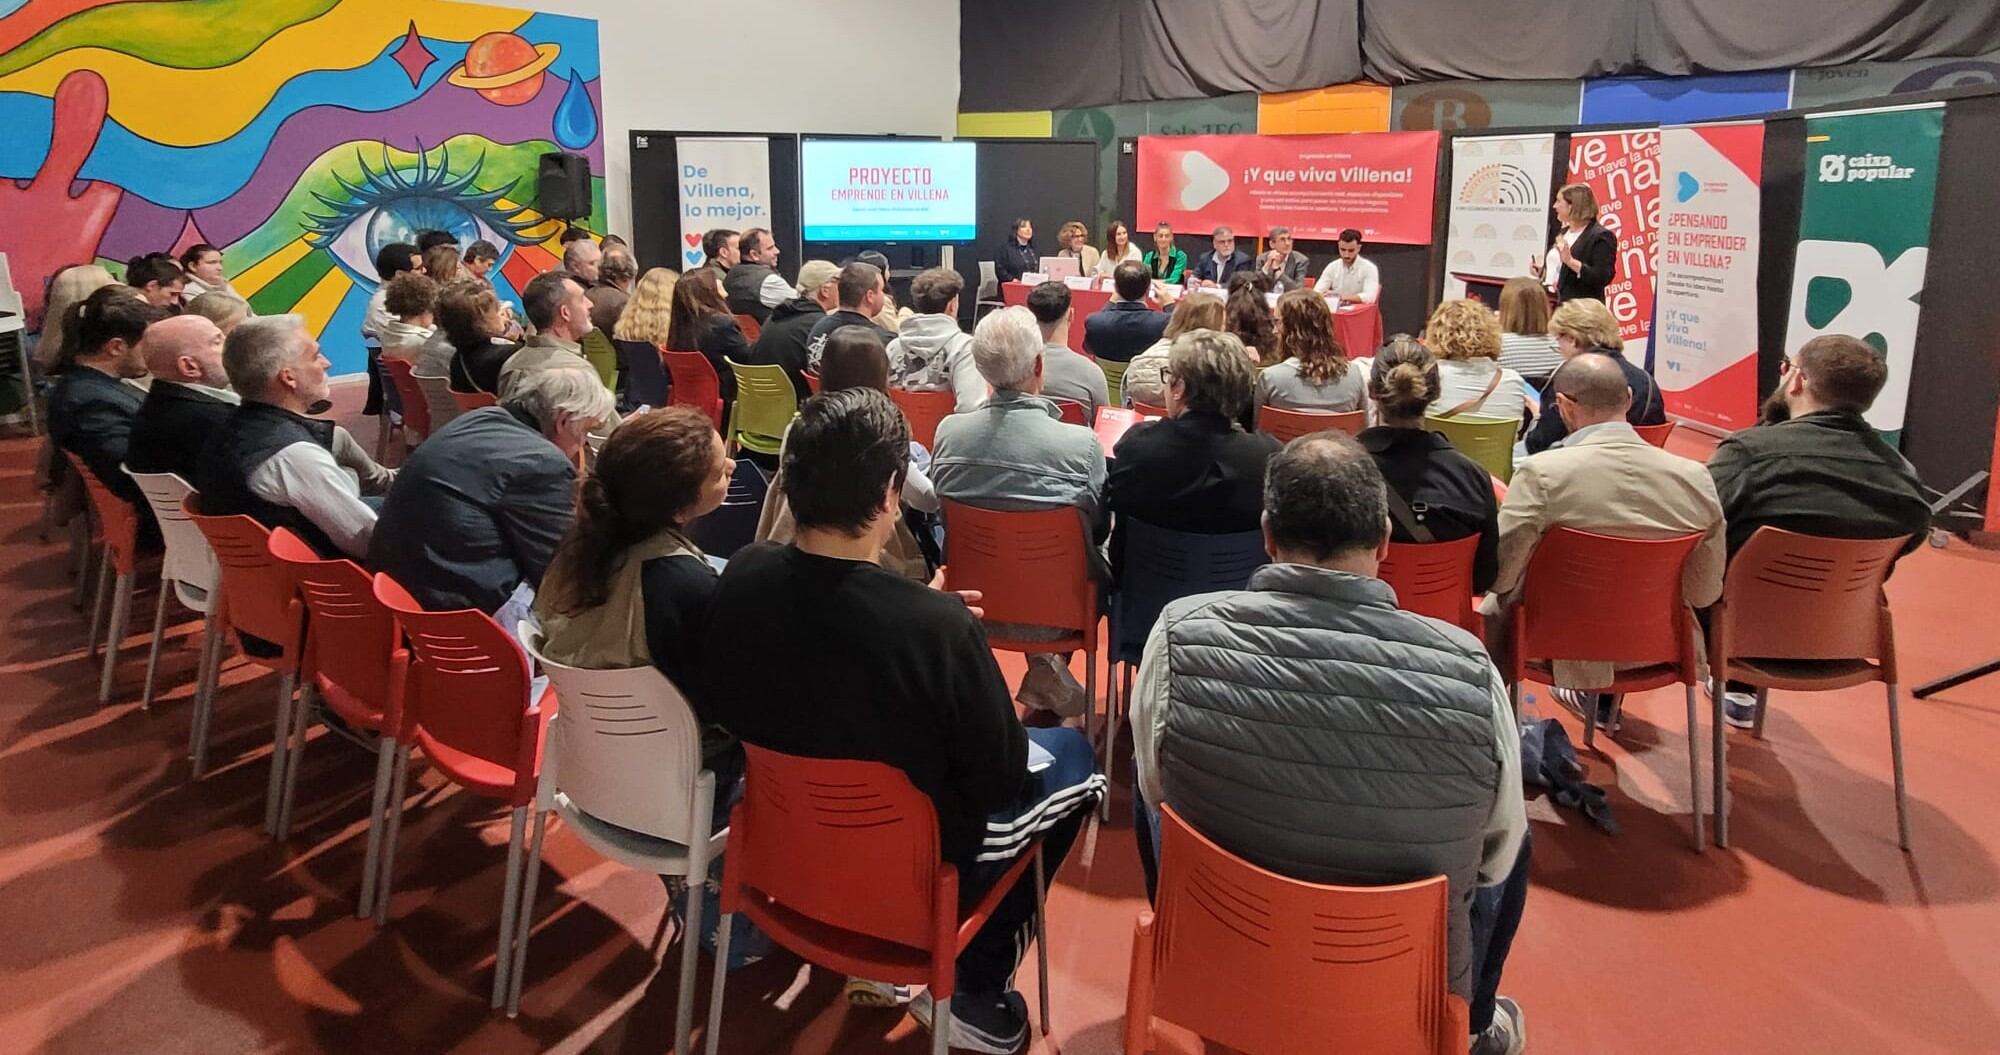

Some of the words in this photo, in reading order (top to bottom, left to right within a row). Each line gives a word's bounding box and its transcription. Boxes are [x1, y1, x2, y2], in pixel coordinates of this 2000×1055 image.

[1584, 168, 1596, 181] la
[1598, 157, 1627, 176] nave
[1629, 151, 1642, 164] la
[1848, 153, 1892, 167] caixa
[684, 165, 708, 178] De
[849, 167, 932, 185] PROYECTO
[1244, 167, 1260, 184] ¡Y
[1264, 169, 1296, 186] que
[1299, 166, 1337, 182] viva
[1340, 167, 1412, 184] Villena!
[1846, 165, 1915, 182] popular
[684, 183, 754, 199] Villena,
[831, 189, 887, 201] EMPRENDE
[891, 189, 904, 200] EN
[907, 189, 949, 201] VILLENA
[685, 203, 702, 217] lo
[707, 202, 766, 221] mejor.
[1668, 213, 1728, 230] ¿PENSANDO
[1632, 234, 1645, 247] la
[1668, 231, 1680, 245] EN
[1684, 232, 1747, 251] EMPRENDER
[1667, 250, 1680, 264] EN
[1683, 252, 1732, 270] VILLENA?
[1680, 312, 1700, 324] que
[1665, 320, 1689, 334] viva
[1665, 333, 1707, 351] Villena!
